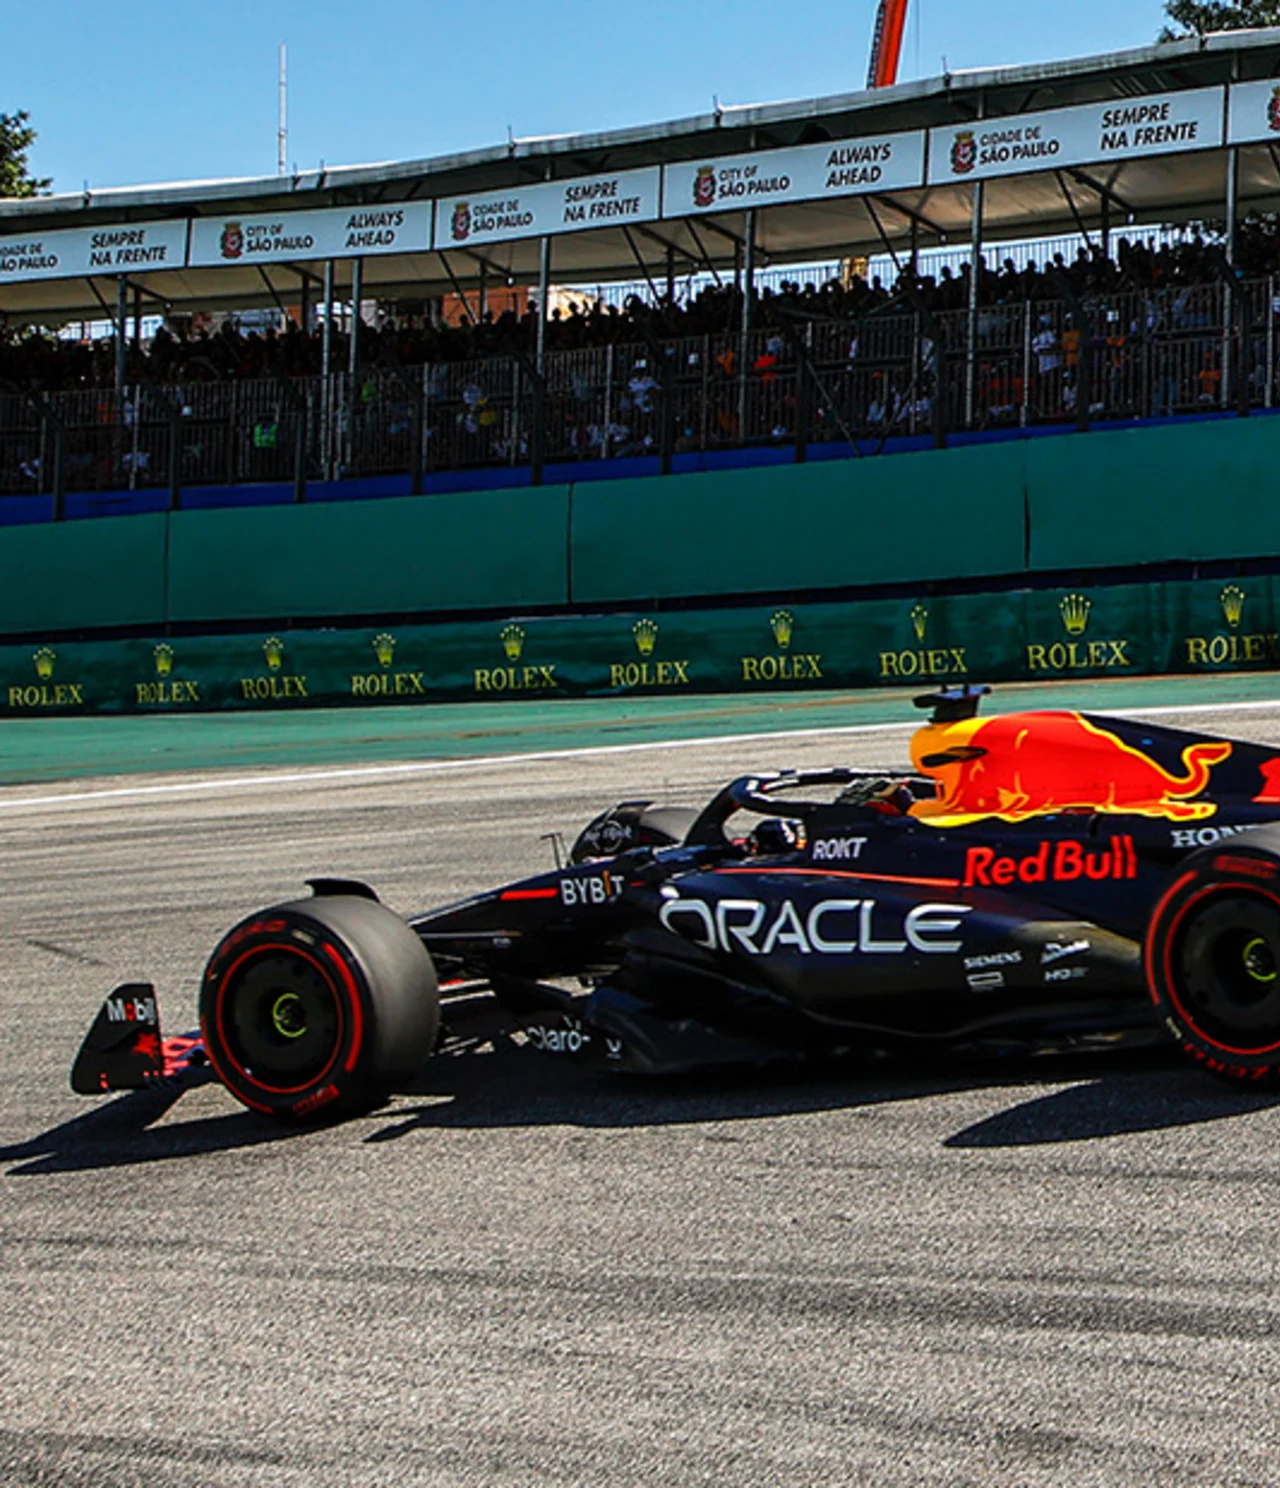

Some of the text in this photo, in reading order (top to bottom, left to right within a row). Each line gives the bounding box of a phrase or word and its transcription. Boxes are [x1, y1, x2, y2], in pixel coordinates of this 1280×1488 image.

[1101, 103, 1171, 129] SEMPRE
[979, 126, 1042, 148] CIDADE DE
[1101, 121, 1199, 151] NA FRENTE
[826, 143, 892, 167] ALWAYS
[978, 140, 1061, 166] SÃO PAULO
[718, 165, 758, 182] CITY OF
[825, 165, 882, 189] AHEAD
[564, 180, 619, 204] SEMPRE
[718, 175, 791, 200] SÃO PAULO
[346, 210, 405, 231] ALWAYS
[473, 199, 520, 217] CIDADE DE
[563, 196, 641, 224] NA FRENTE
[246, 223, 284, 238] CITY OF
[471, 211, 534, 234] SÃO PAULO
[90, 230, 145, 250] SEMPRE
[245, 233, 314, 254] SÃO PAULO
[345, 229, 396, 249] AHEAD
[19, 253, 58, 271] PAULO
[89, 245, 168, 268] NA FRENTE
[741, 653, 824, 681] ROLEX
[1027, 638, 1131, 671] ROLEX
[350, 671, 425, 696] ROLEX
[473, 664, 559, 692] ROLEX
[609, 660, 690, 687] ROLEX
[7, 682, 84, 708] ROLEX
[135, 680, 201, 704] ROLEX
[239, 675, 309, 700] ROLEX
[811, 836, 868, 861] ROKT
[1170, 824, 1258, 849] HON
[963, 834, 1139, 887] Red Bull
[560, 869, 626, 906] BYBIT
[658, 898, 974, 955] ORACLE
